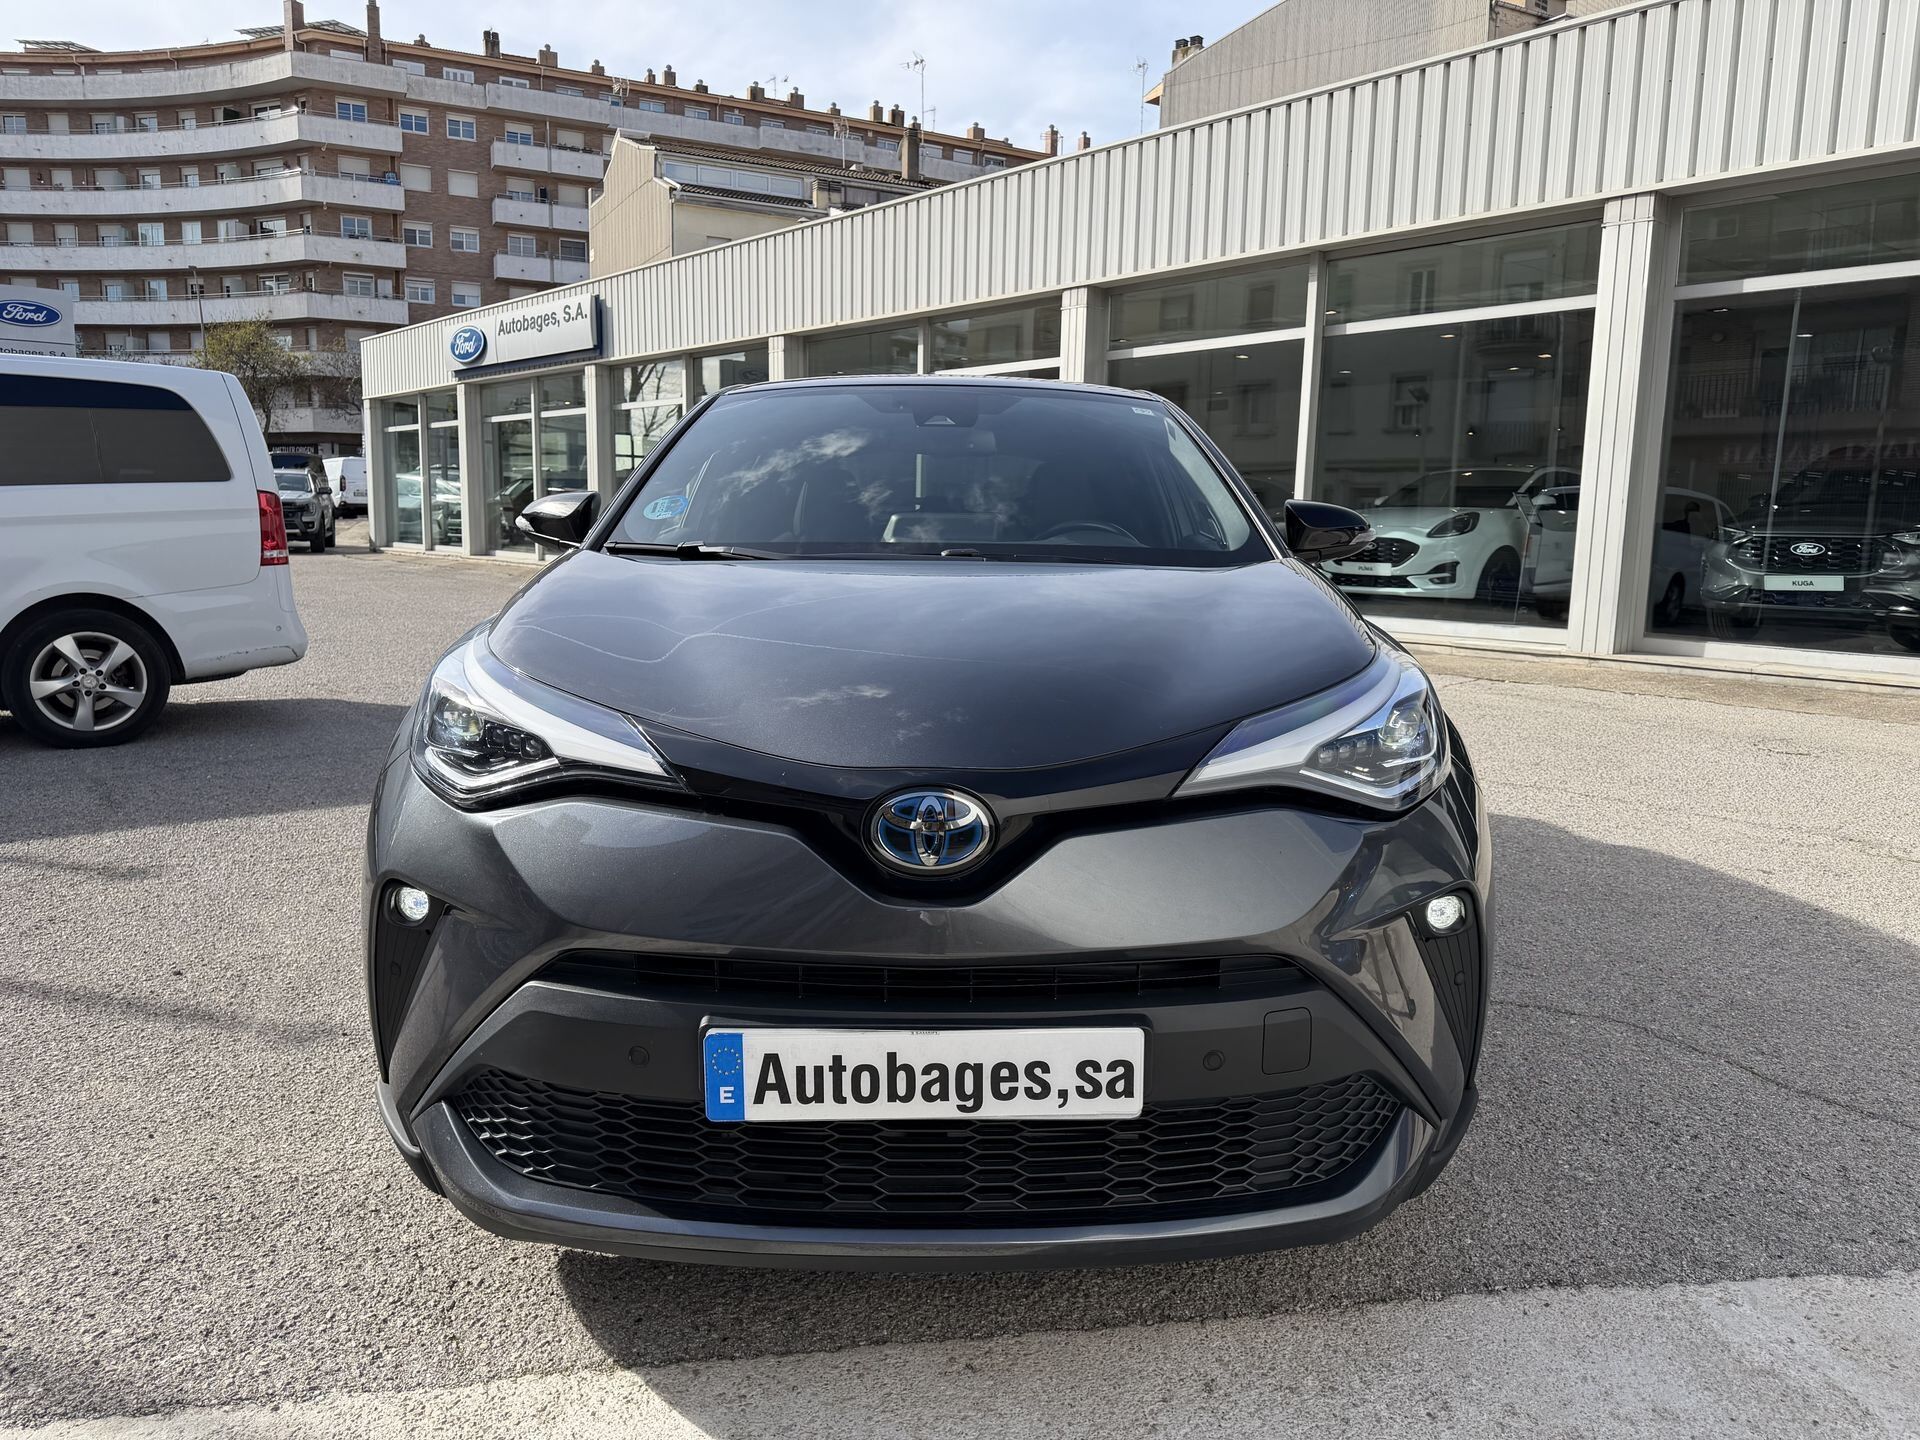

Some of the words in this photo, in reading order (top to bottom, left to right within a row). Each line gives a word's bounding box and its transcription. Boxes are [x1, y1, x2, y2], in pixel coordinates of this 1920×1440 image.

[2, 303, 47, 322] Ford
[498, 311, 560, 336] Autobages,
[563, 302, 588, 323] S.A.
[454, 331, 476, 356] Ford
[1796, 544, 1819, 554] Ford
[719, 1086, 735, 1104] E
[752, 1051, 1136, 1114] Autobages,sa
